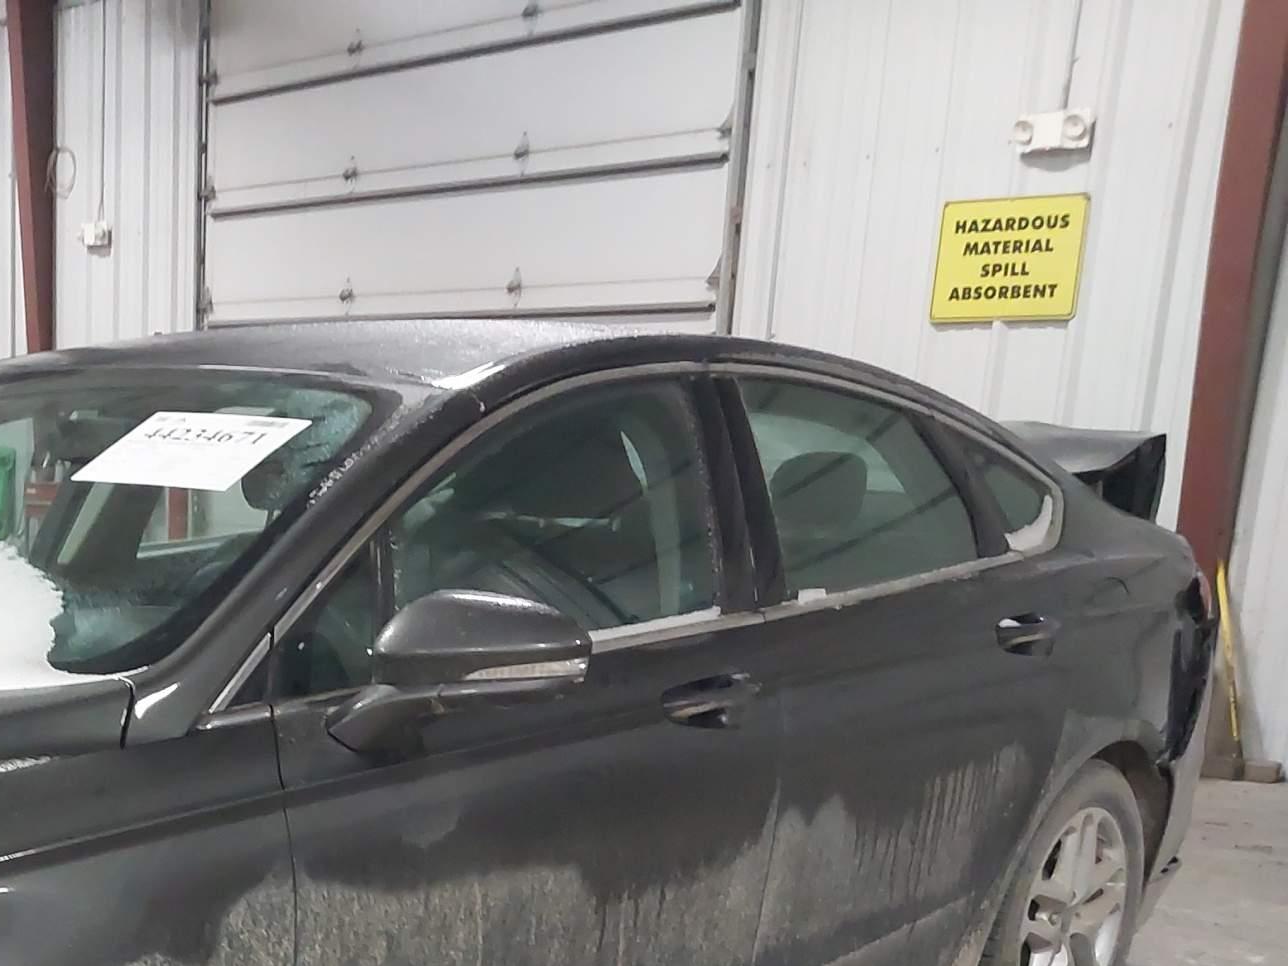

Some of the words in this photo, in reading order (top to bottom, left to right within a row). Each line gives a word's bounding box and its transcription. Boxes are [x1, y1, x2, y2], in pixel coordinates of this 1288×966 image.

[954, 213, 1071, 235] HAZARDOUS
[962, 238, 1055, 257] MATERIAL
[979, 261, 1030, 278] SPILL
[947, 283, 1059, 302] ABSORBENT
[144, 425, 268, 446] 44234671
